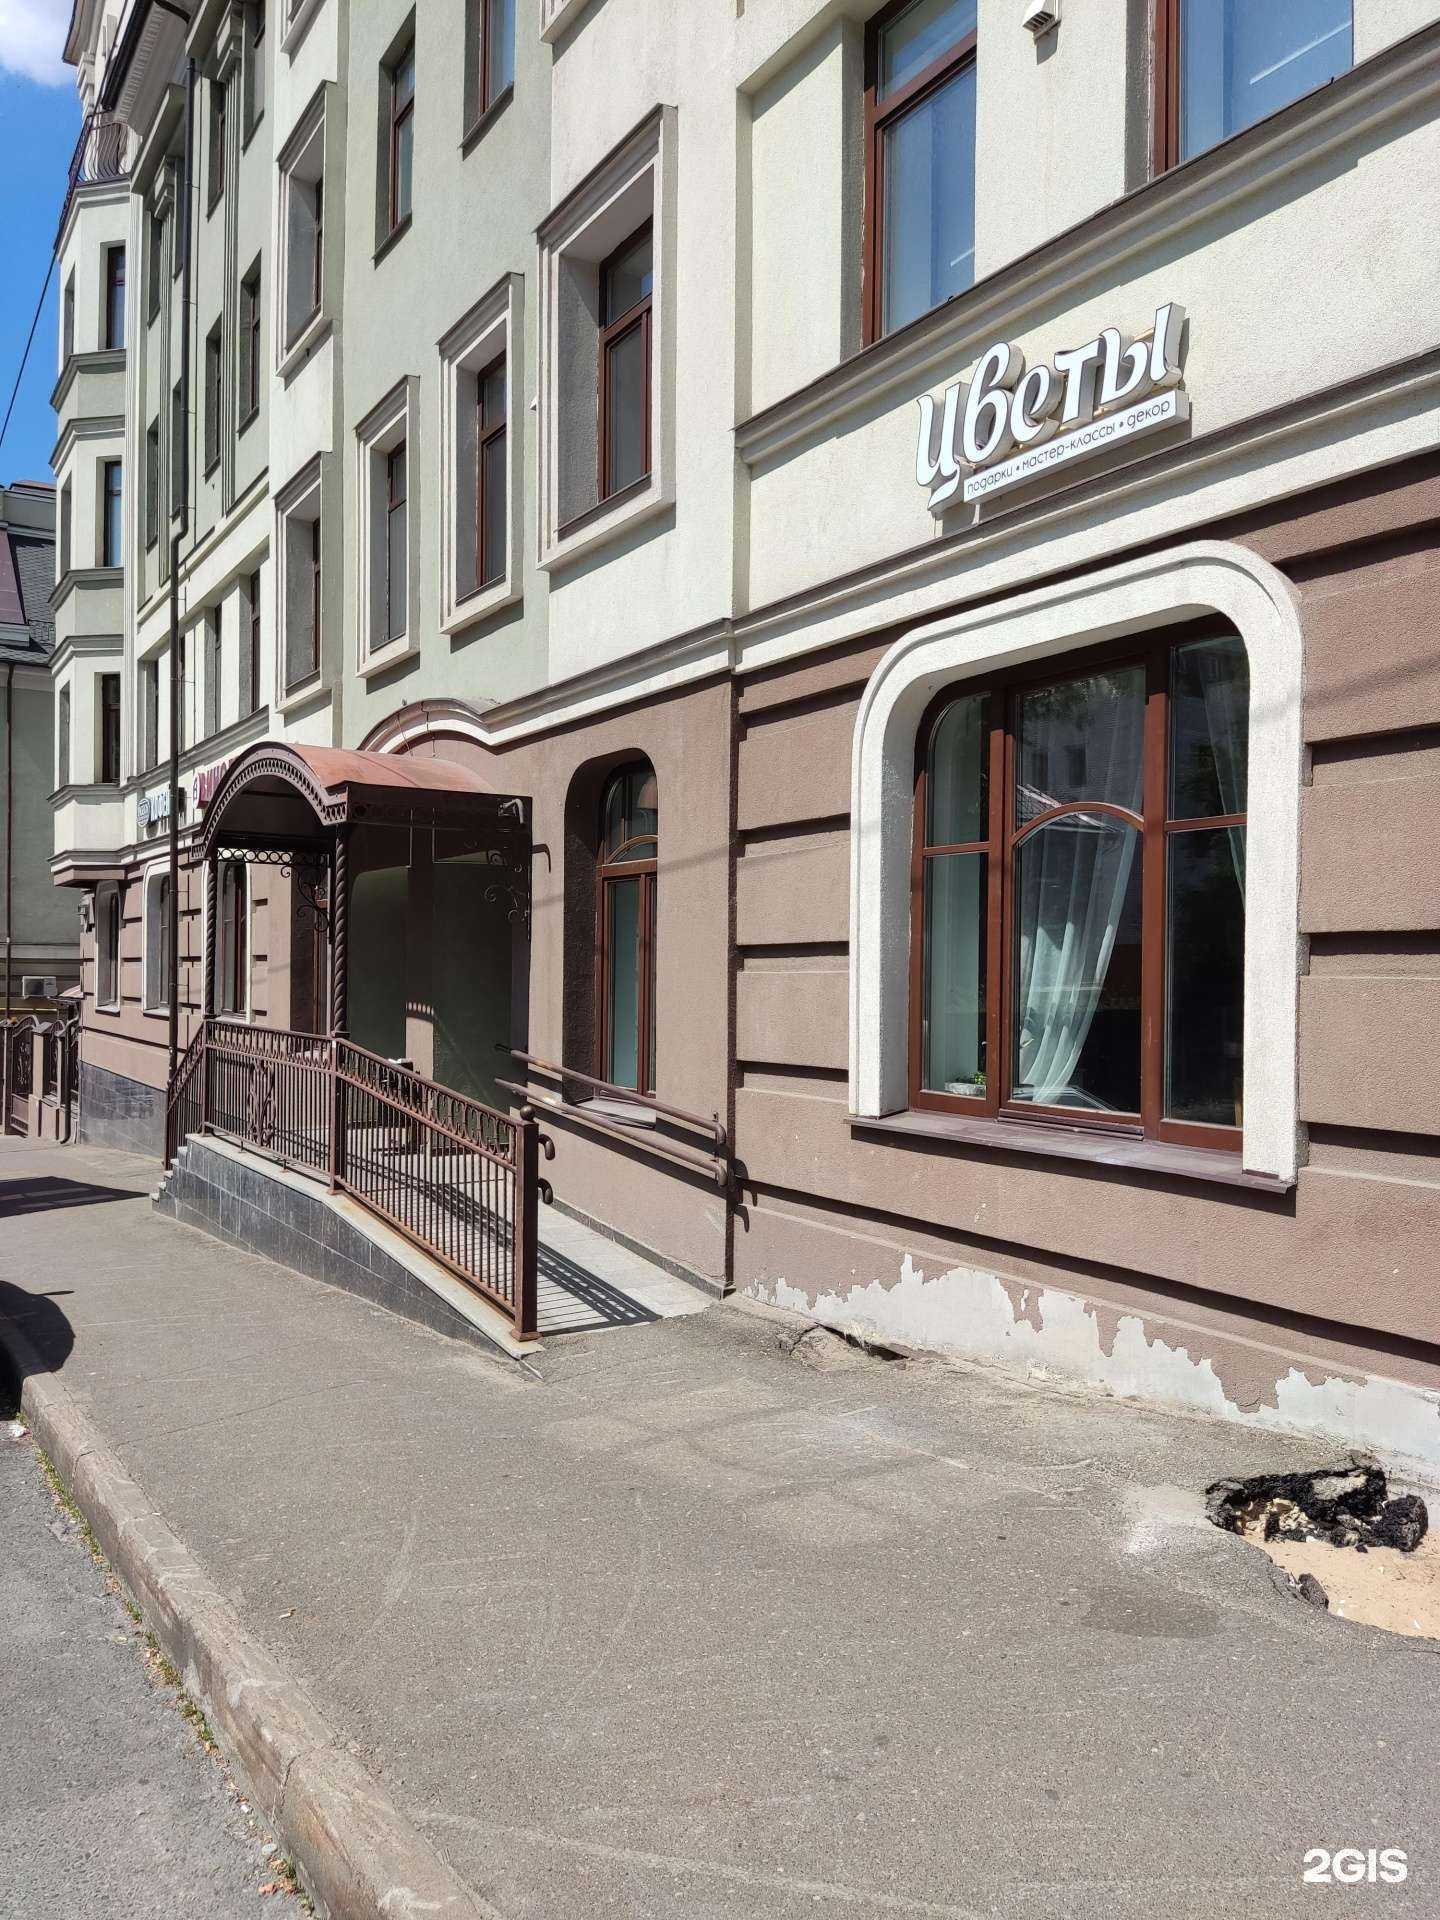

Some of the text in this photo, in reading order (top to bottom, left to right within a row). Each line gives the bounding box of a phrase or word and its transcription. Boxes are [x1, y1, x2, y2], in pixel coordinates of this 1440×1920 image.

[967, 400, 1170, 494] подарки мастер-классы декор
